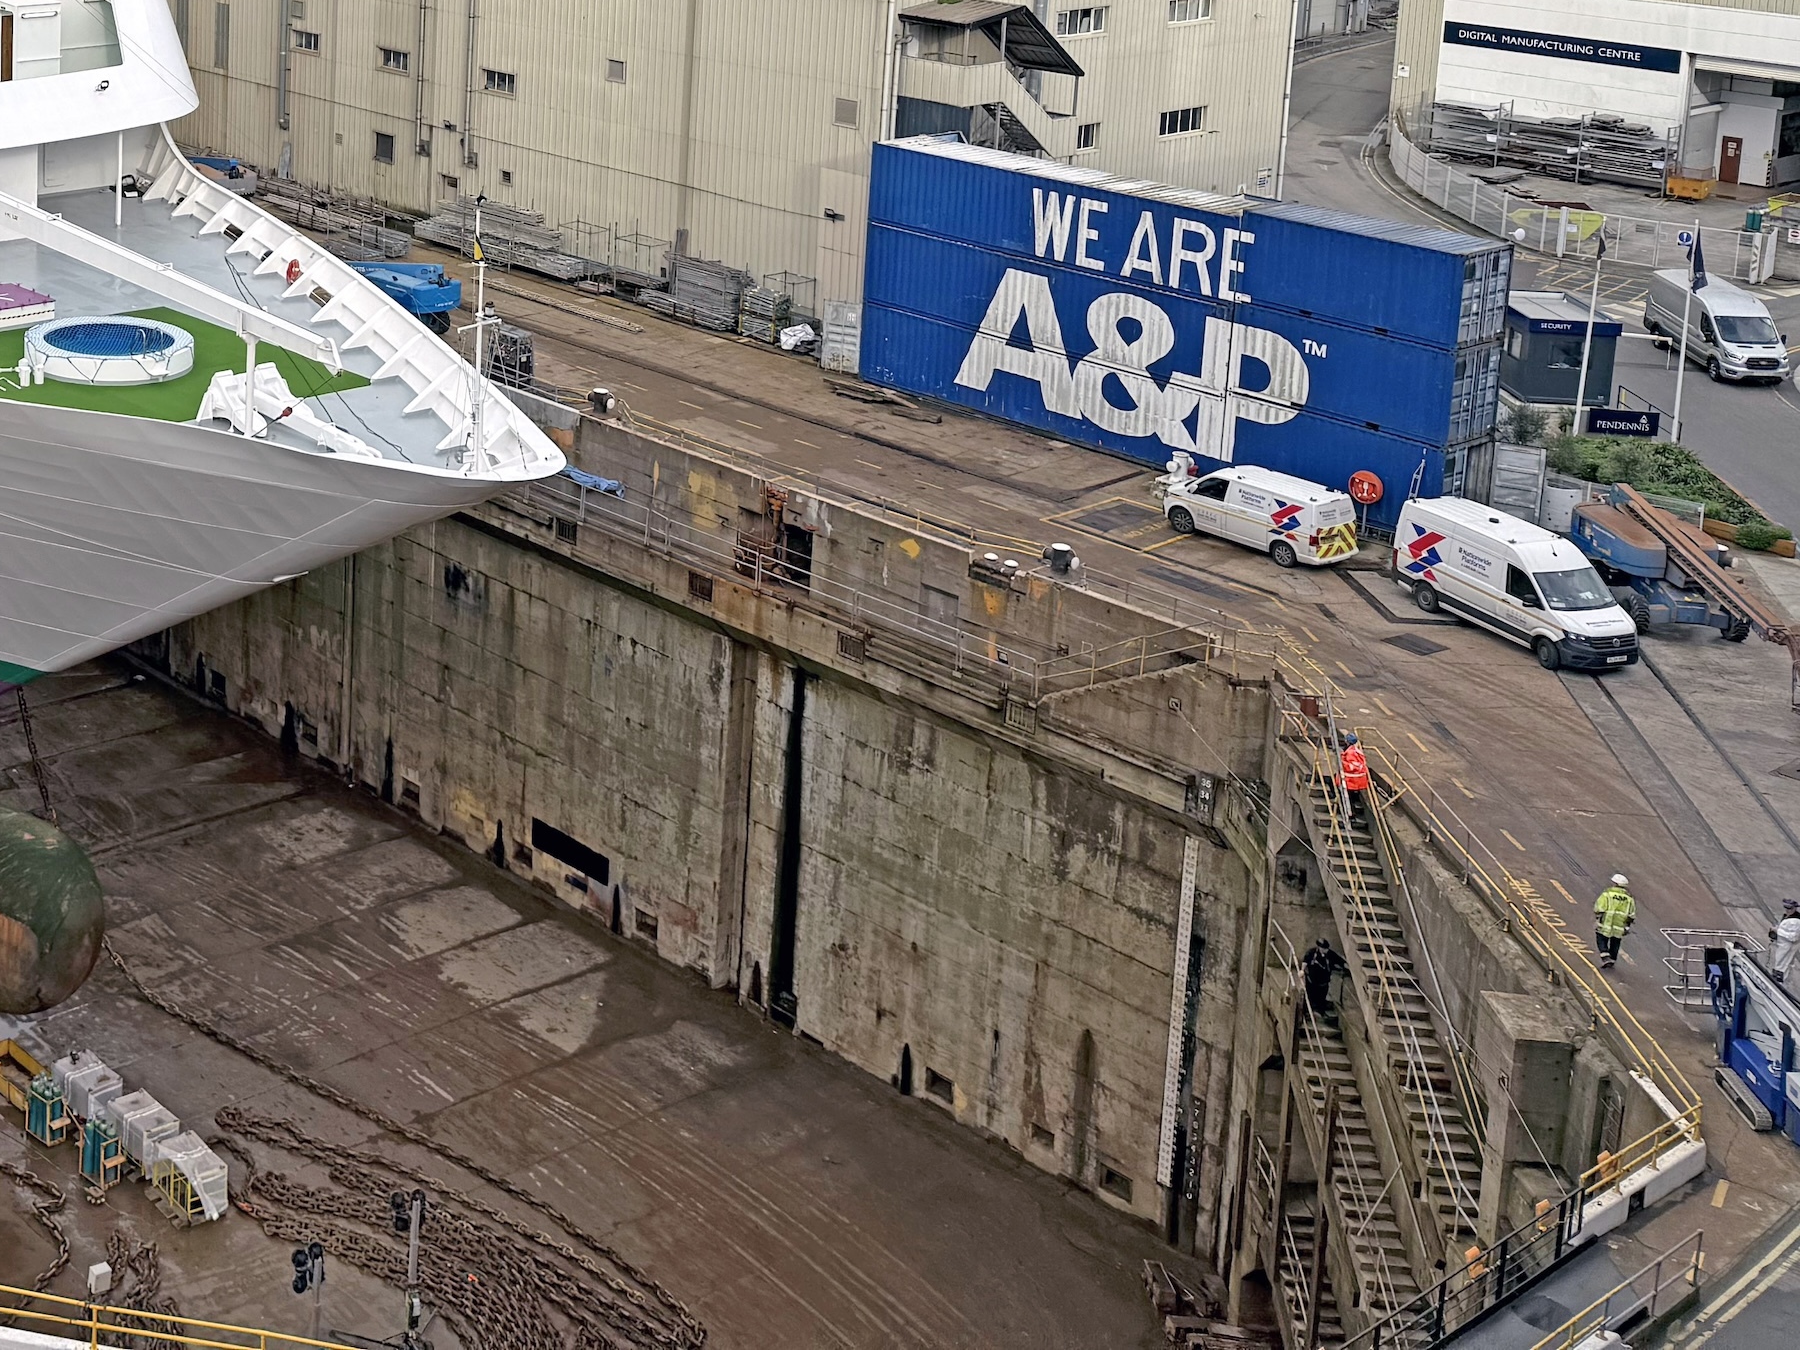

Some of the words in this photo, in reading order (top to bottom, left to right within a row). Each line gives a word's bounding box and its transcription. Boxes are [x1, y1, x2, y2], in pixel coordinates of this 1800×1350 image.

[1458, 29, 1497, 43] DIGITAL
[1501, 35, 1594, 55] MANUFACTURING
[1598, 47, 1641, 62] CENTRE
[1032, 187, 1109, 271] WE
[1120, 210, 1256, 303] ARE
[1540, 322, 1572, 331] SECURITY
[953, 267, 1310, 463] A&P
[1596, 420, 1651, 432] PENDENNIS
[1463, 549, 1492, 567] Nationwide
